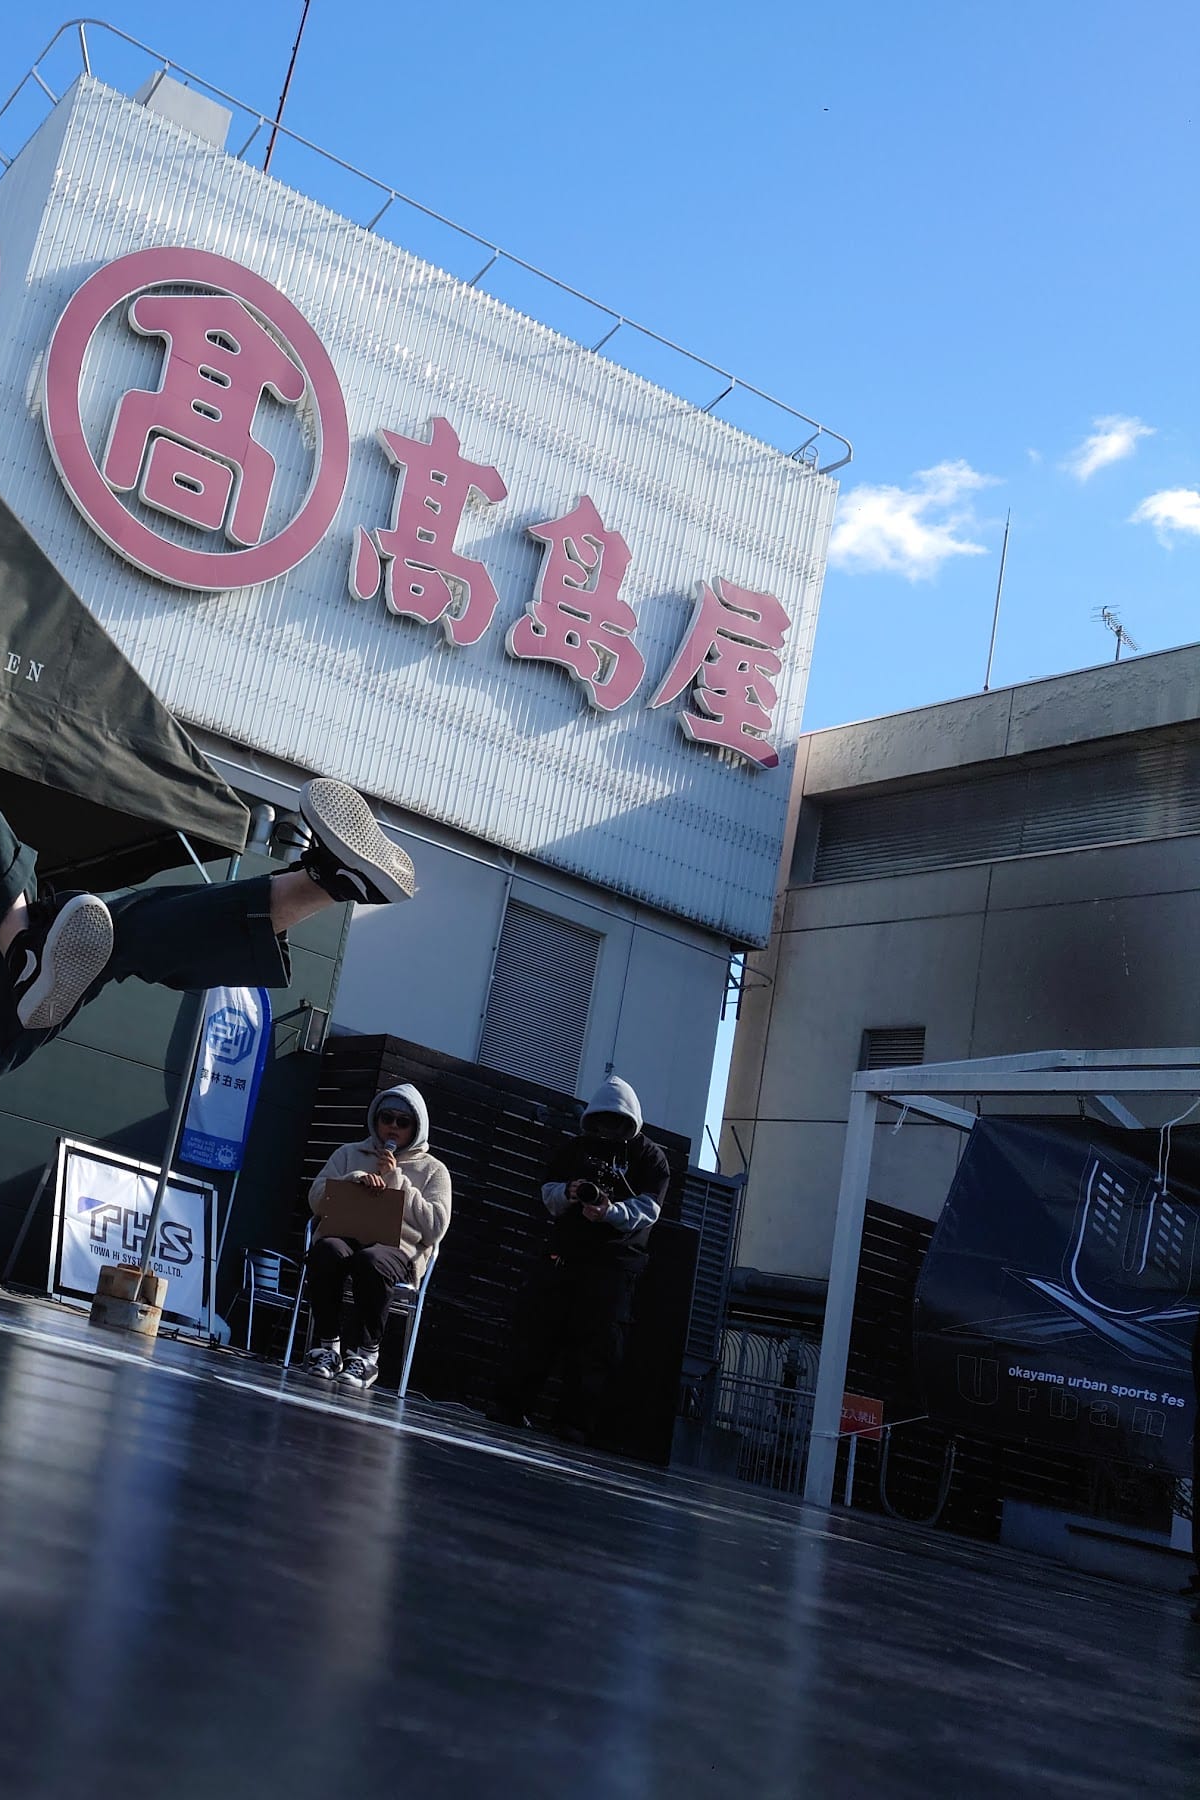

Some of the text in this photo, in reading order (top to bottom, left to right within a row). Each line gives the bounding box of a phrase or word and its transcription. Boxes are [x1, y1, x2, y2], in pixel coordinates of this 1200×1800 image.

[90, 1244, 110, 1258] TOWA
[122, 1253, 151, 1271] SYST
[1008, 1365, 1186, 1408] okayama urban sports fes
